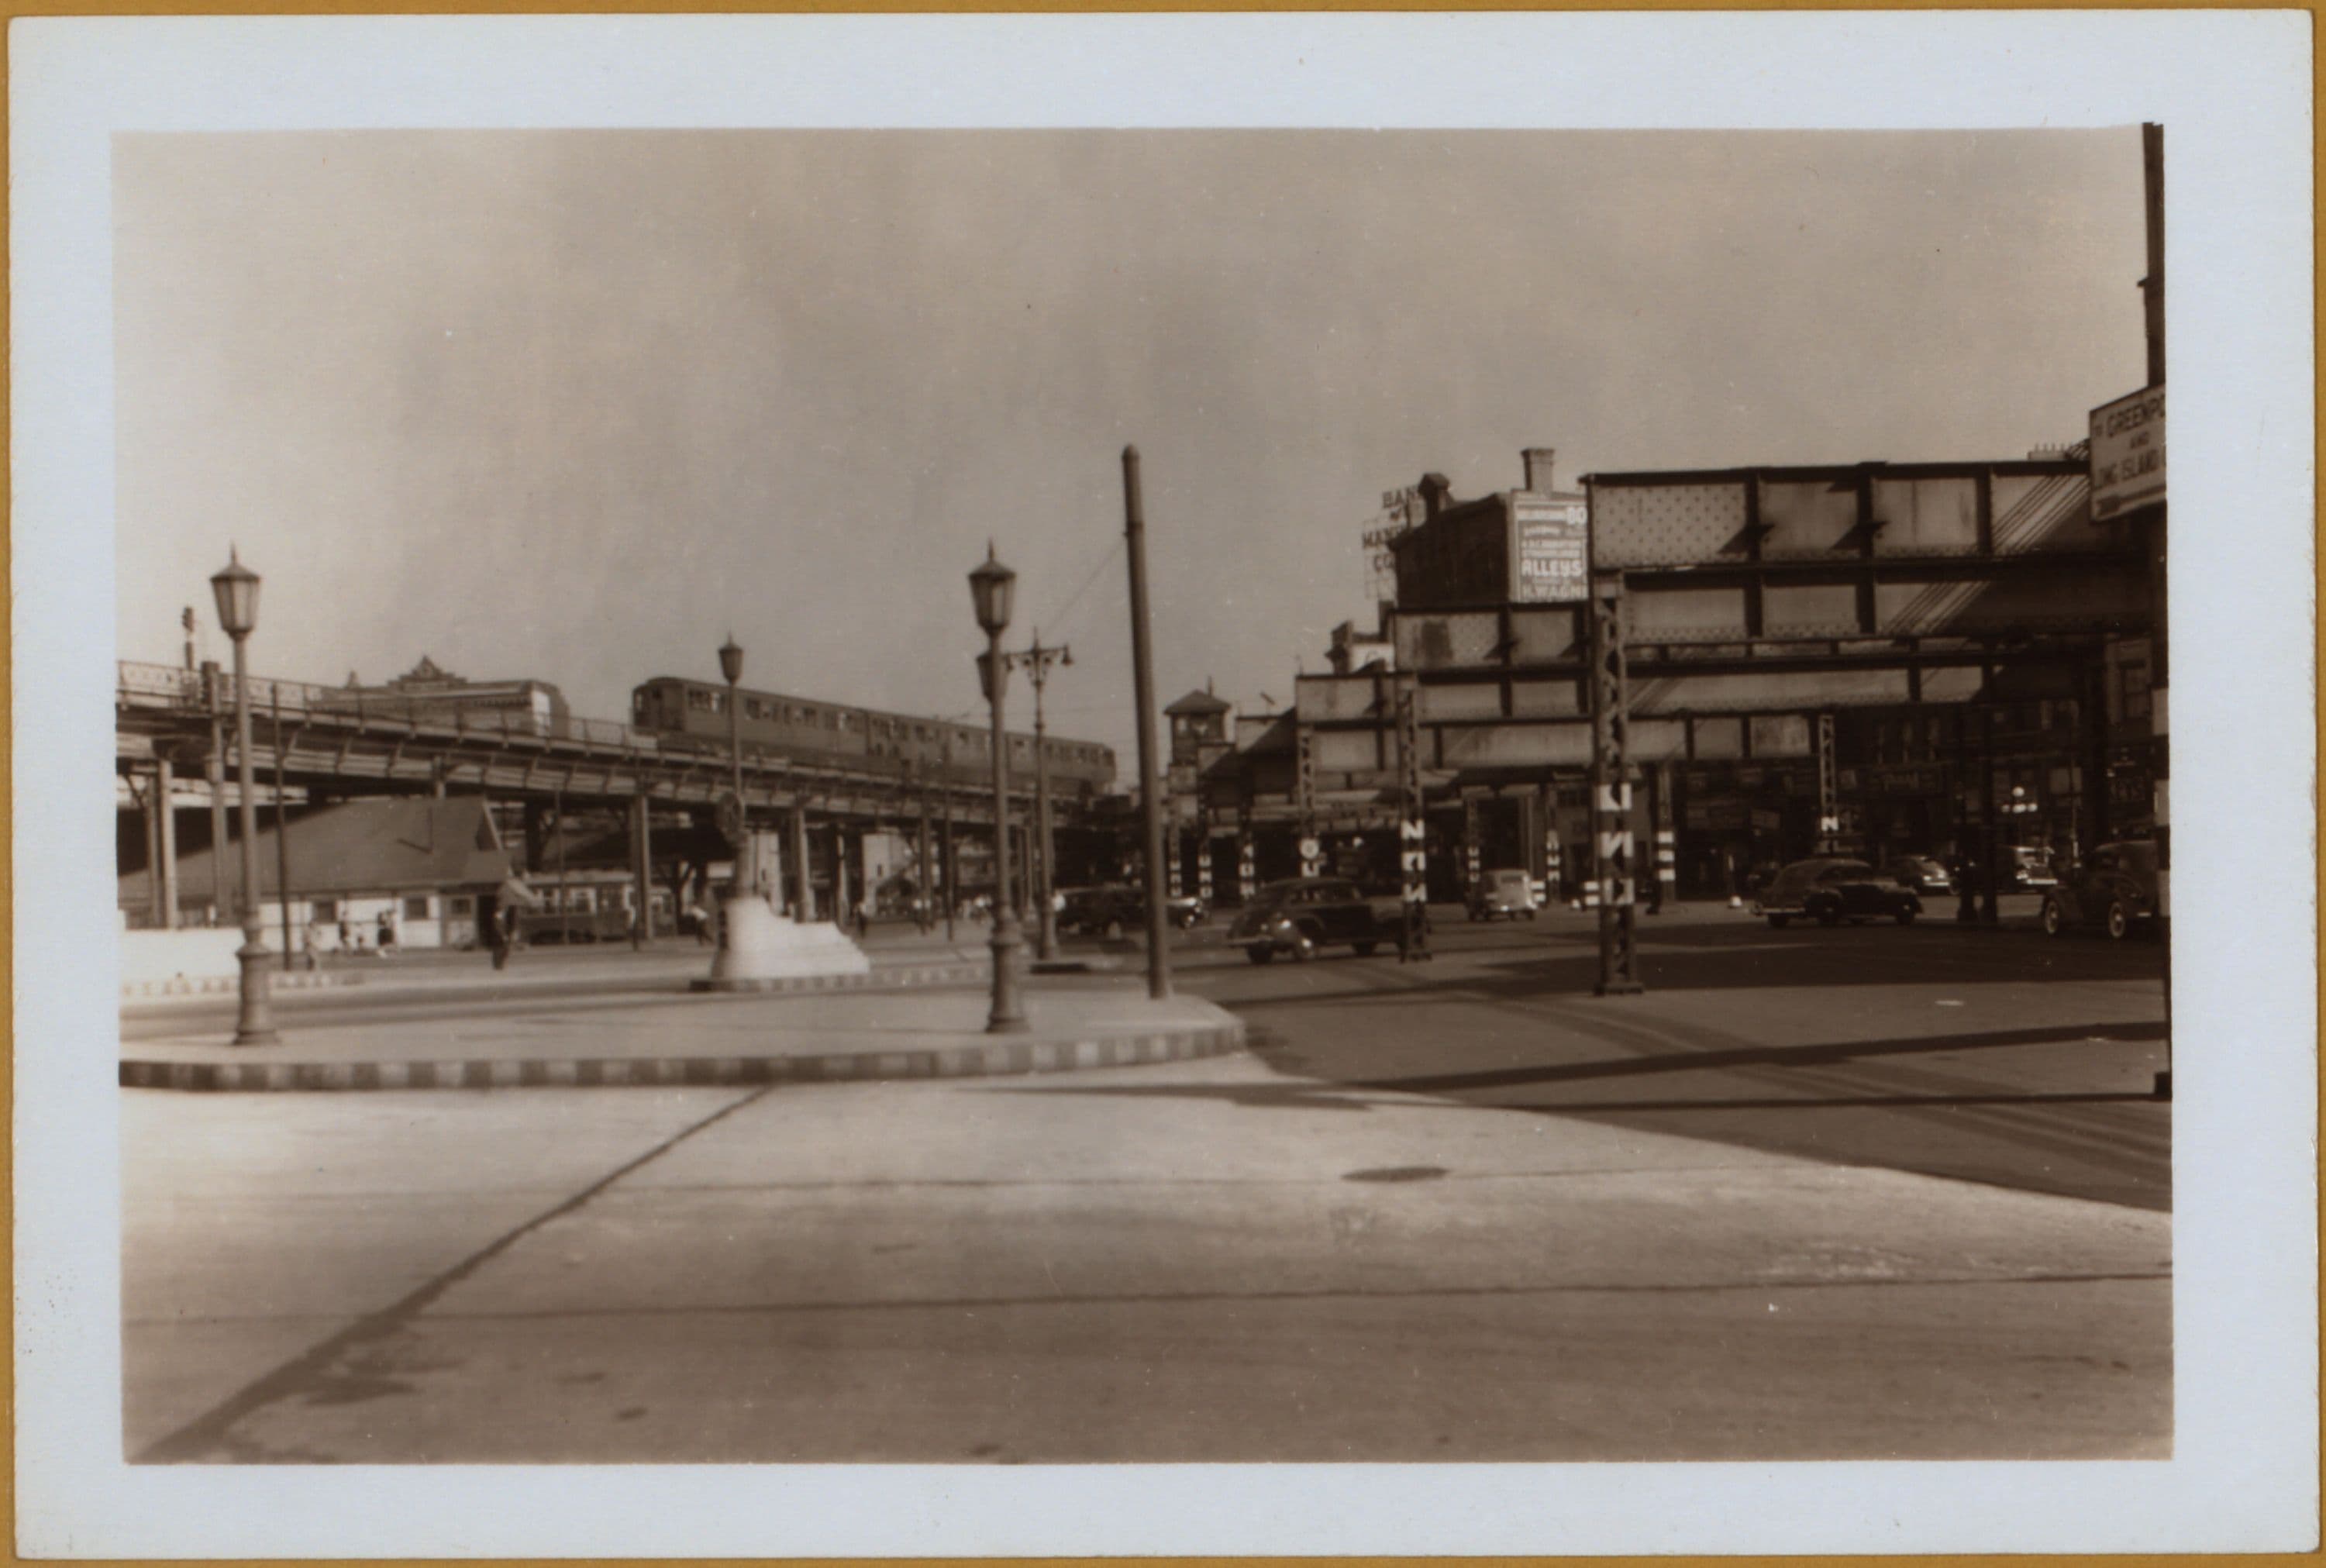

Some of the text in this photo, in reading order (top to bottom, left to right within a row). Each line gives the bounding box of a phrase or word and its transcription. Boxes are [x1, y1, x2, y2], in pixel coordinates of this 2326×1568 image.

[2129, 430, 2150, 450] AND
[2121, 448, 2160, 481] ISLAND
[1382, 484, 1420, 508] BAN
[1521, 559, 1582, 577] ALLEYS
